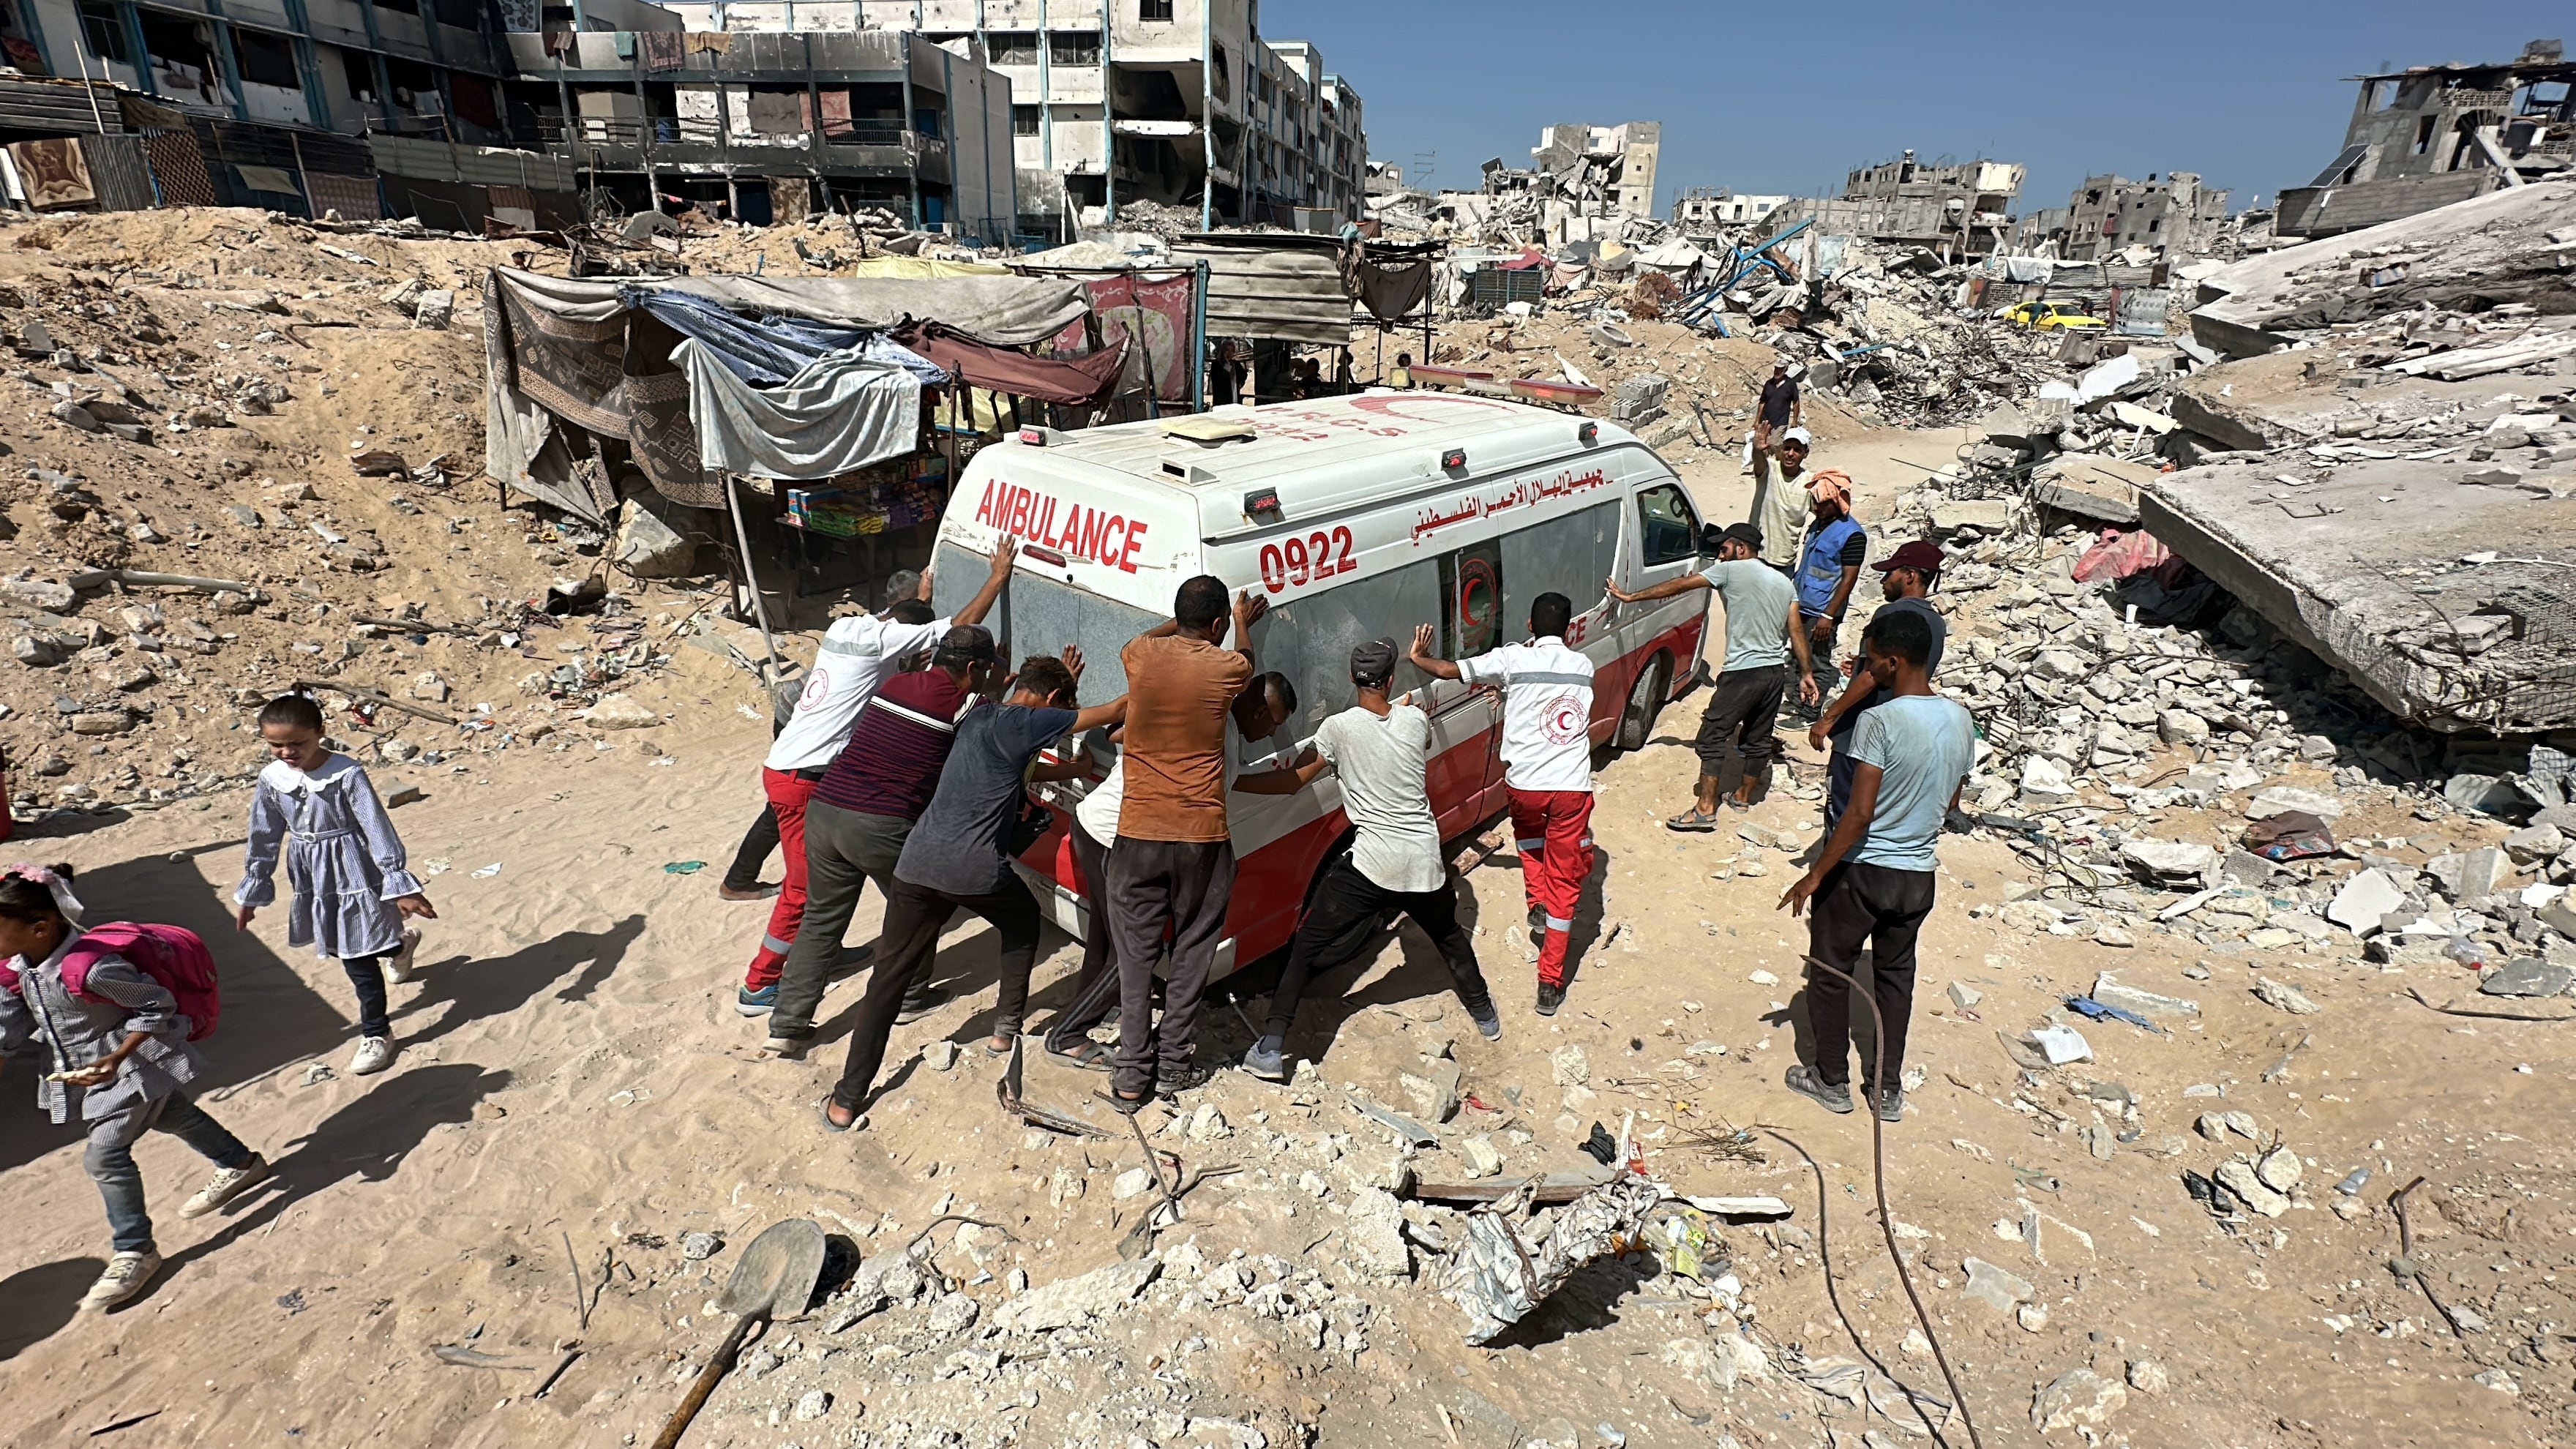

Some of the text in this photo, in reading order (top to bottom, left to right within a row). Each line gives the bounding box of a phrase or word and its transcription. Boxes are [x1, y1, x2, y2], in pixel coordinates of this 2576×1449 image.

[975, 478, 1148, 574] AMBULANCE
[1410, 495, 1481, 547] الفلسطيني
[1483, 479, 1528, 519] الأحمر
[1259, 525, 1358, 594] 0922
